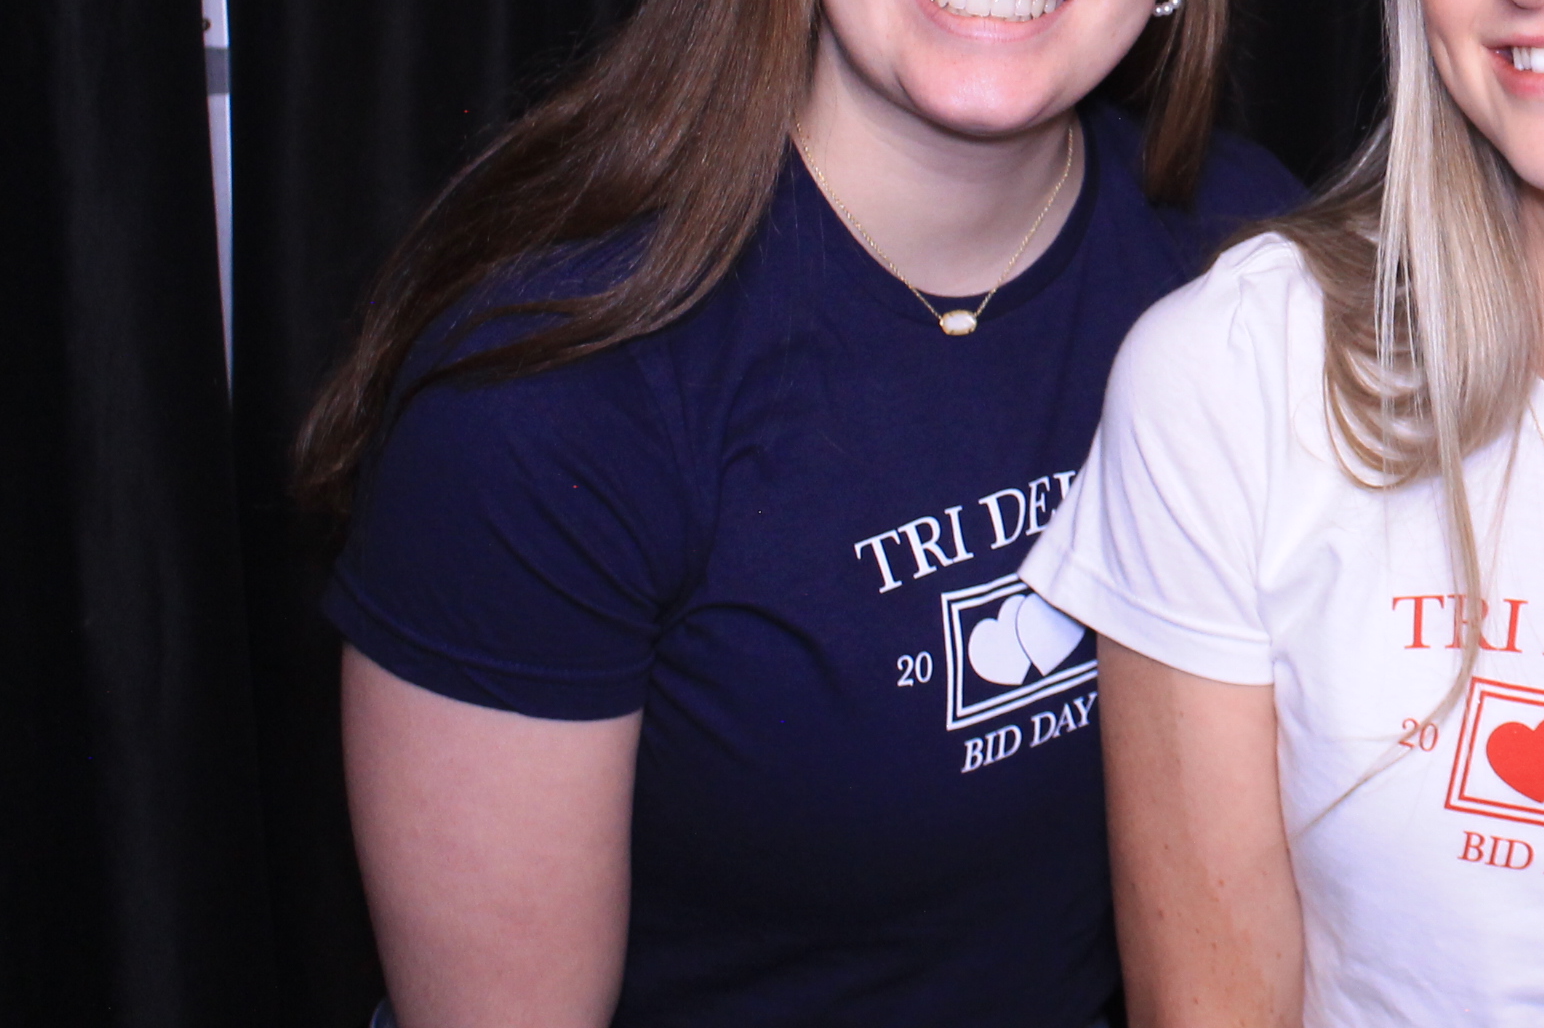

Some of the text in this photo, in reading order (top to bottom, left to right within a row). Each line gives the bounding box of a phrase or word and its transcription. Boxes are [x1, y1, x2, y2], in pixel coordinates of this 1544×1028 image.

[854, 505, 974, 594] TRI
[1392, 593, 1528, 653] TRI
[896, 651, 934, 687] 20
[961, 692, 1098, 773] BID DAY
[1399, 718, 1439, 752] 20
[1458, 830, 1534, 871] BID
